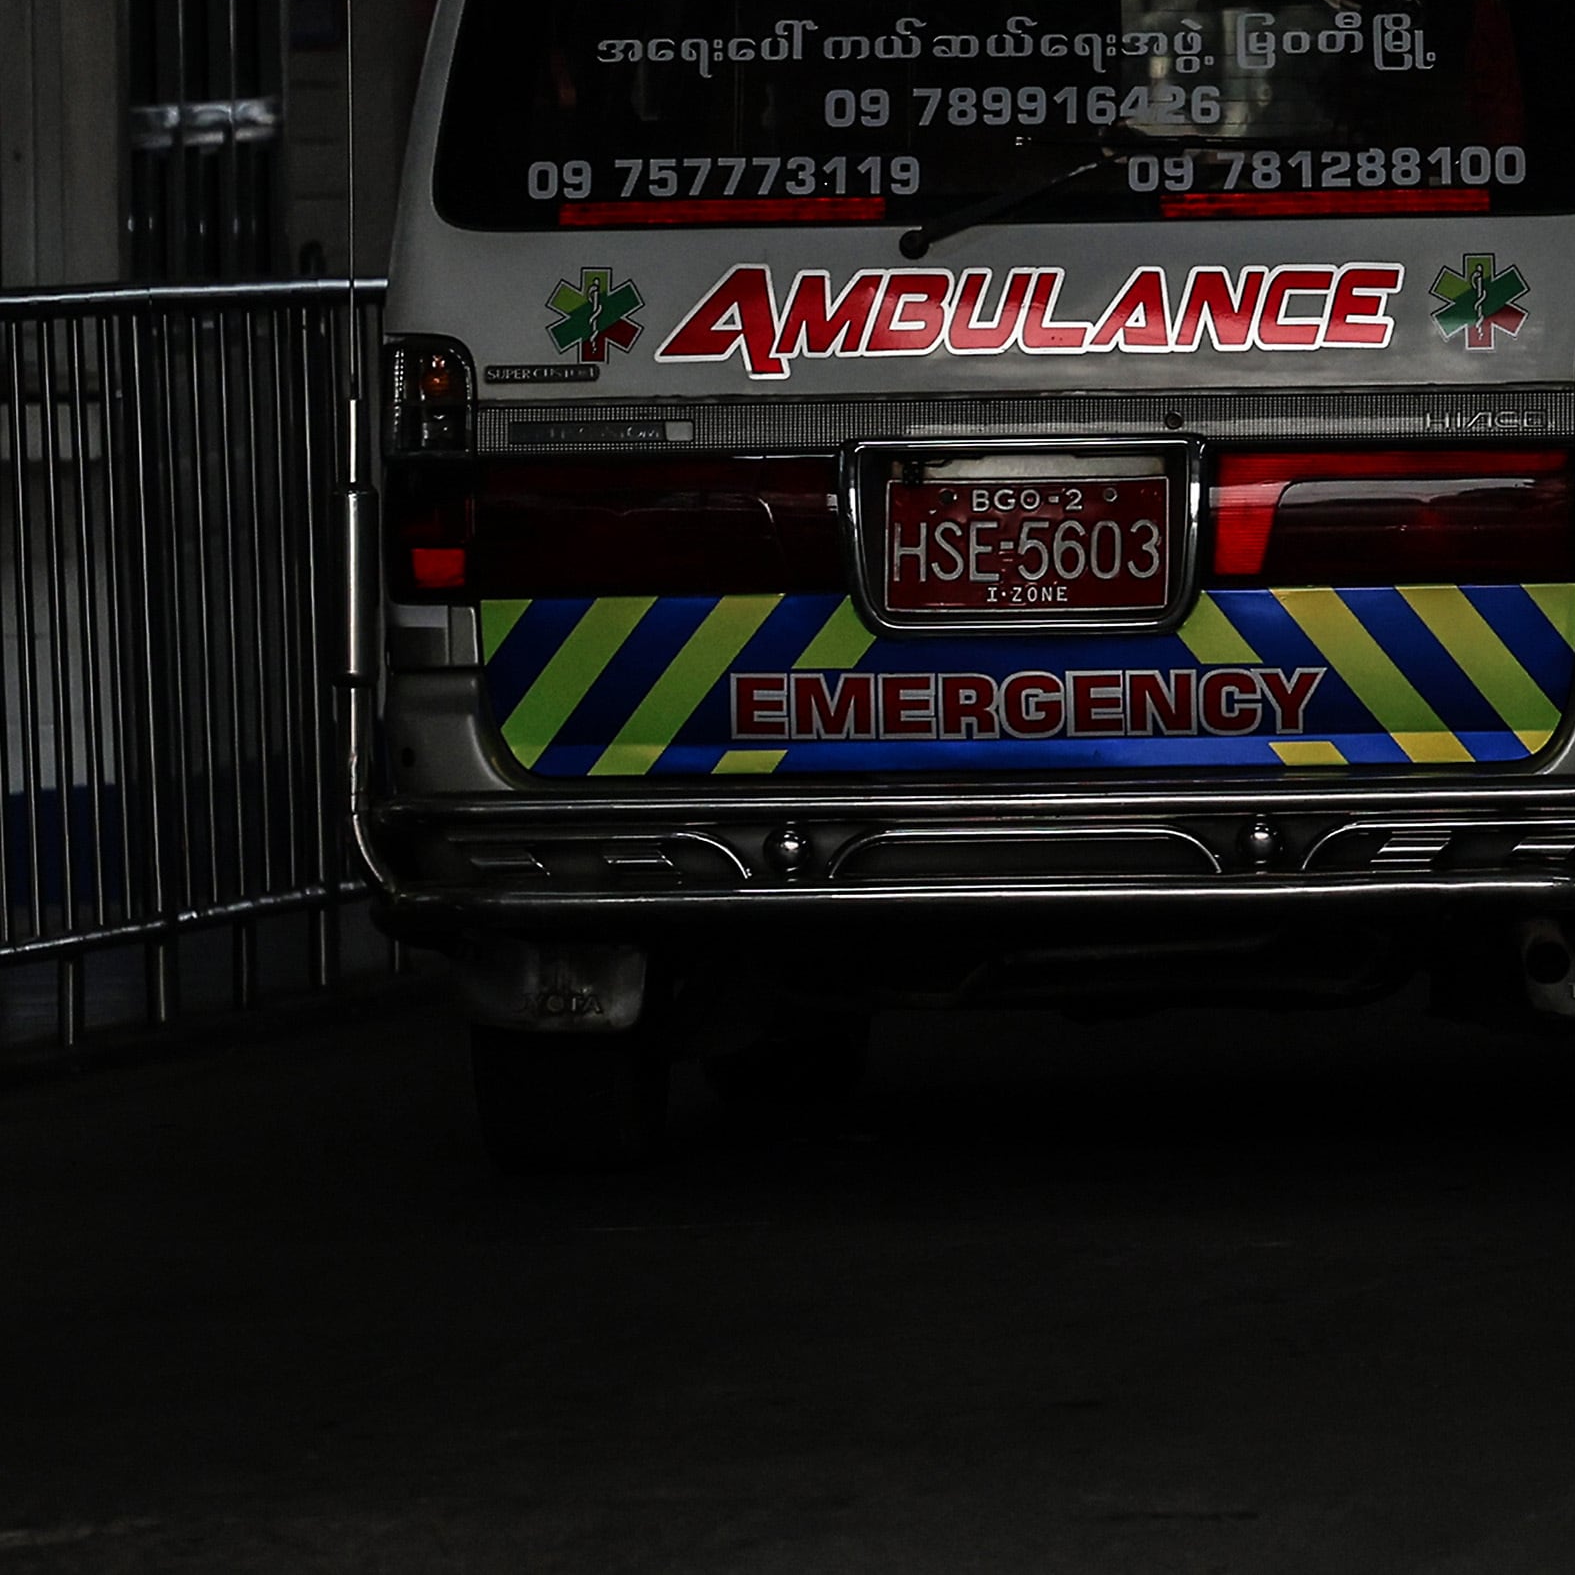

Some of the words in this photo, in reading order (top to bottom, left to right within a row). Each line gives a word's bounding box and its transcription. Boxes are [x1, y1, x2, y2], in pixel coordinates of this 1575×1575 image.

[824, 87, 891, 128] 09
[911, 84, 1222, 127] 789916426
[526, 159, 593, 201] 09
[613, 154, 921, 198] 757773119
[1126, 154, 1195, 193] 09
[1216, 144, 1528, 192] 781288100
[654, 262, 1404, 380] AMBULANCE
[487, 365, 531, 381] SUPER
[1426, 410, 1547, 430] HIACE
[892, 518, 1162, 584] HSE-5603
[729, 665, 1337, 741] EMERGENCY
